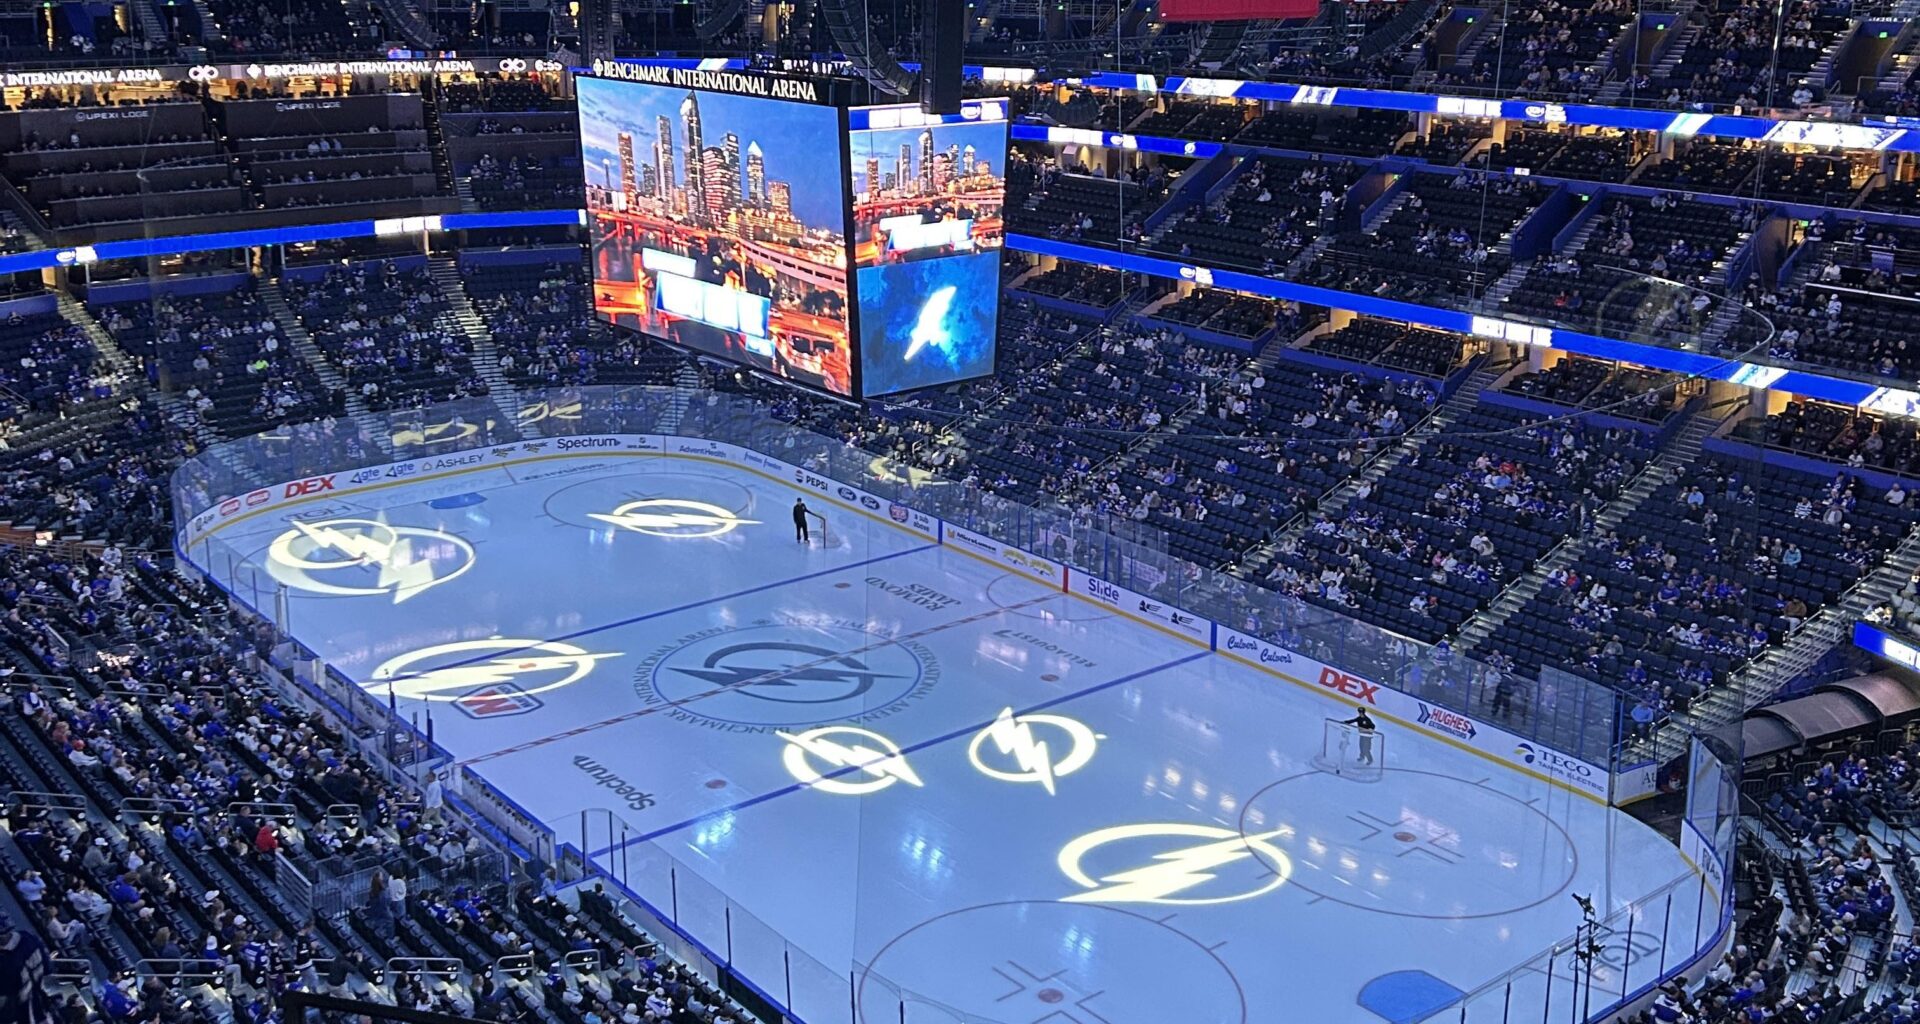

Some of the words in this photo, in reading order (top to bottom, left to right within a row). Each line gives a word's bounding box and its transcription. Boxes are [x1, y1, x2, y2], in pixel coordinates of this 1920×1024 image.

[8, 70, 114, 86] INTERNATIONAL
[117, 69, 162, 82] ARENA
[264, 62, 337, 76] BENCHMARK
[340, 61, 432, 74] INTERNATIONAL
[434, 60, 475, 72] ARENA
[603, 60, 670, 84] BENCHMARK
[673, 68, 768, 96] INTERNATIONAL
[771, 80, 817, 101] ARENA
[557, 437, 617, 451] Spectrum
[435, 454, 484, 469] ASHLEY
[284, 475, 336, 499] DEX
[806, 474, 828, 491] PEPSI
[864, 576, 945, 612] RAYMOND
[903, 583, 961, 606] JAMES
[1088, 578, 1120, 601] Slide
[1012, 631, 1098, 668] RELIAQUEST
[1227, 635, 1259, 651] Culver's
[1260, 648, 1293, 664] Culver's
[632, 645, 678, 705] INTERNATIONAL
[903, 640, 942, 700] INTERNATIONAL
[1318, 666, 1381, 705] DEX
[847, 700, 910, 725] ARENA
[1429, 708, 1470, 732] HUGHES
[1538, 749, 1591, 777] TECO
[576, 756, 656, 811] Spectrum
[1538, 760, 1564, 777] TAMPA
[1566, 772, 1605, 793] ELECTRIC
